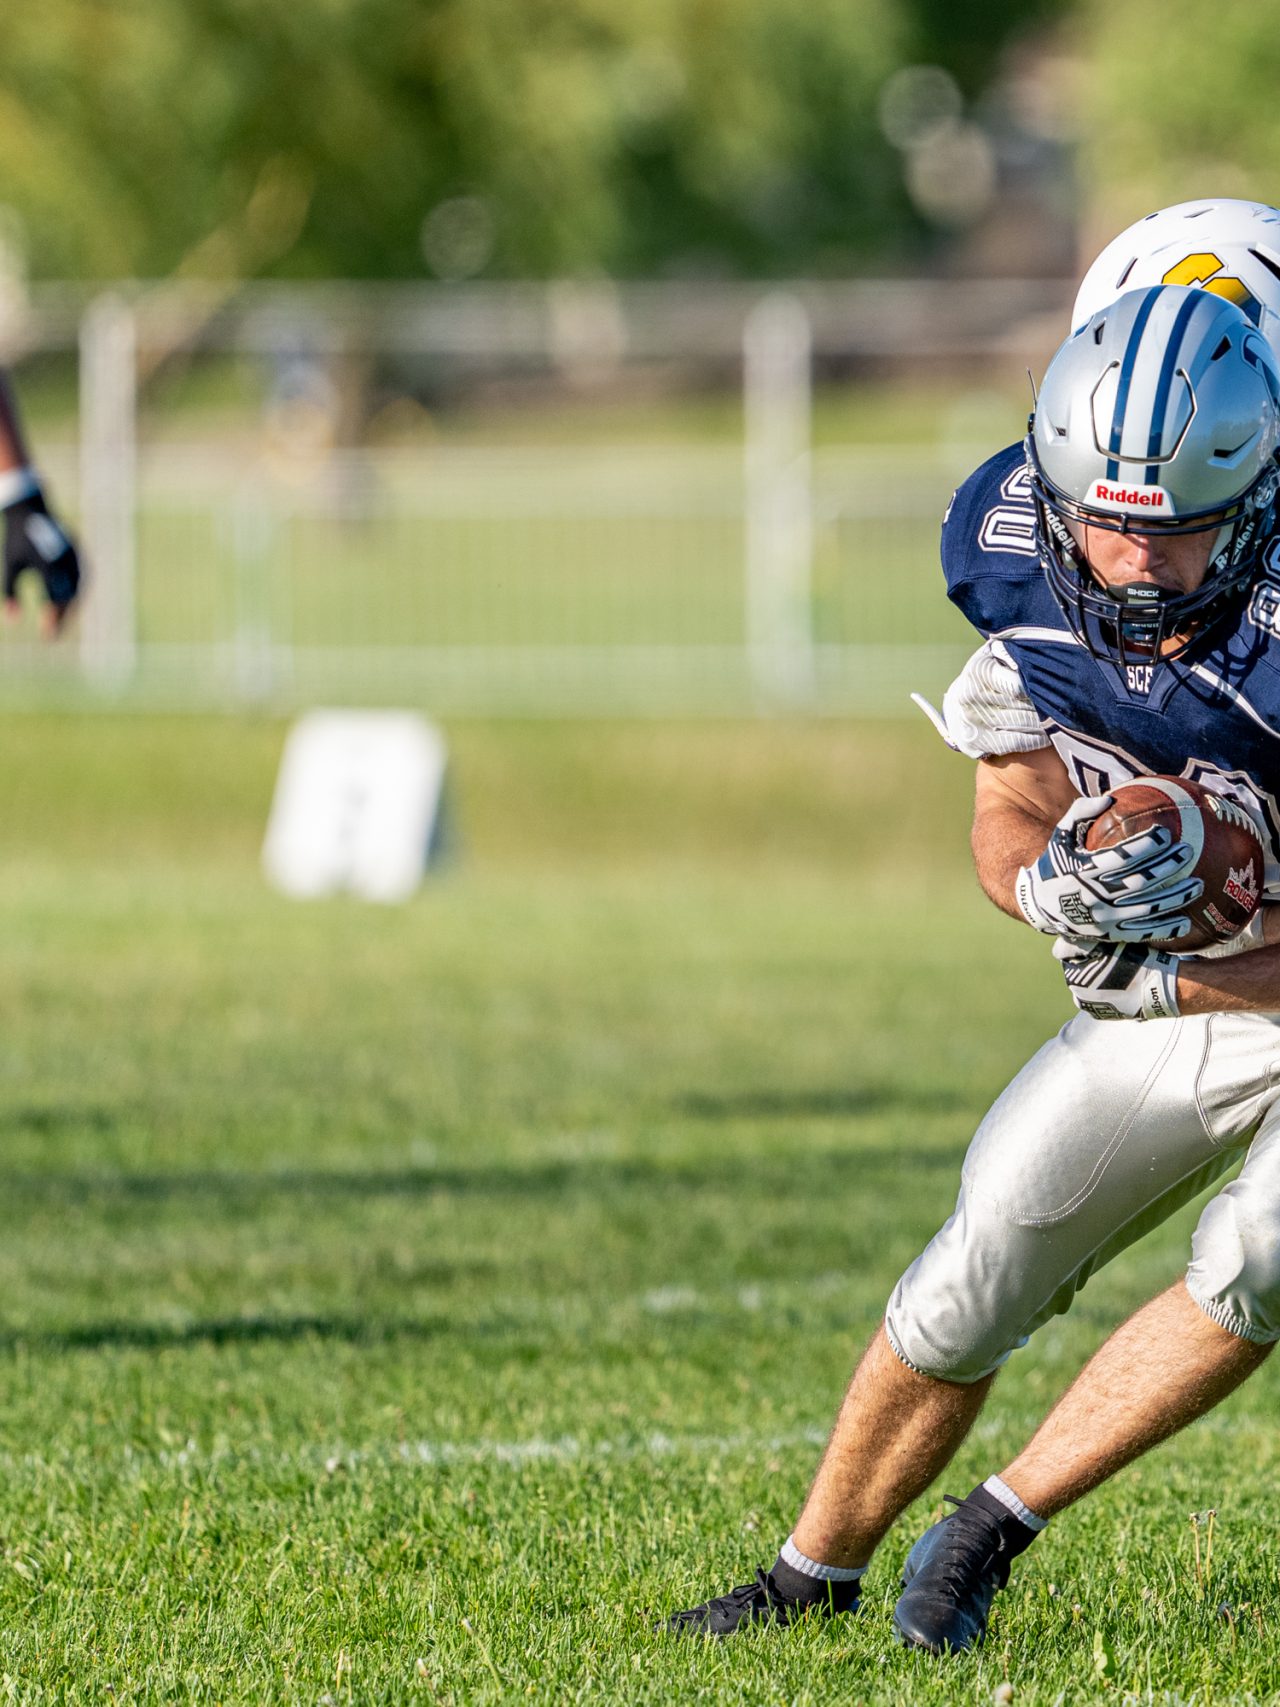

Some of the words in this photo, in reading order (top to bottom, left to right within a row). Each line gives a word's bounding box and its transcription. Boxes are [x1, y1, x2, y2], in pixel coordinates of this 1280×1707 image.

[1096, 484, 1164, 507] Riddell
[1127, 587, 1160, 598] SHOCK
[1062, 895, 1083, 925] NFL
